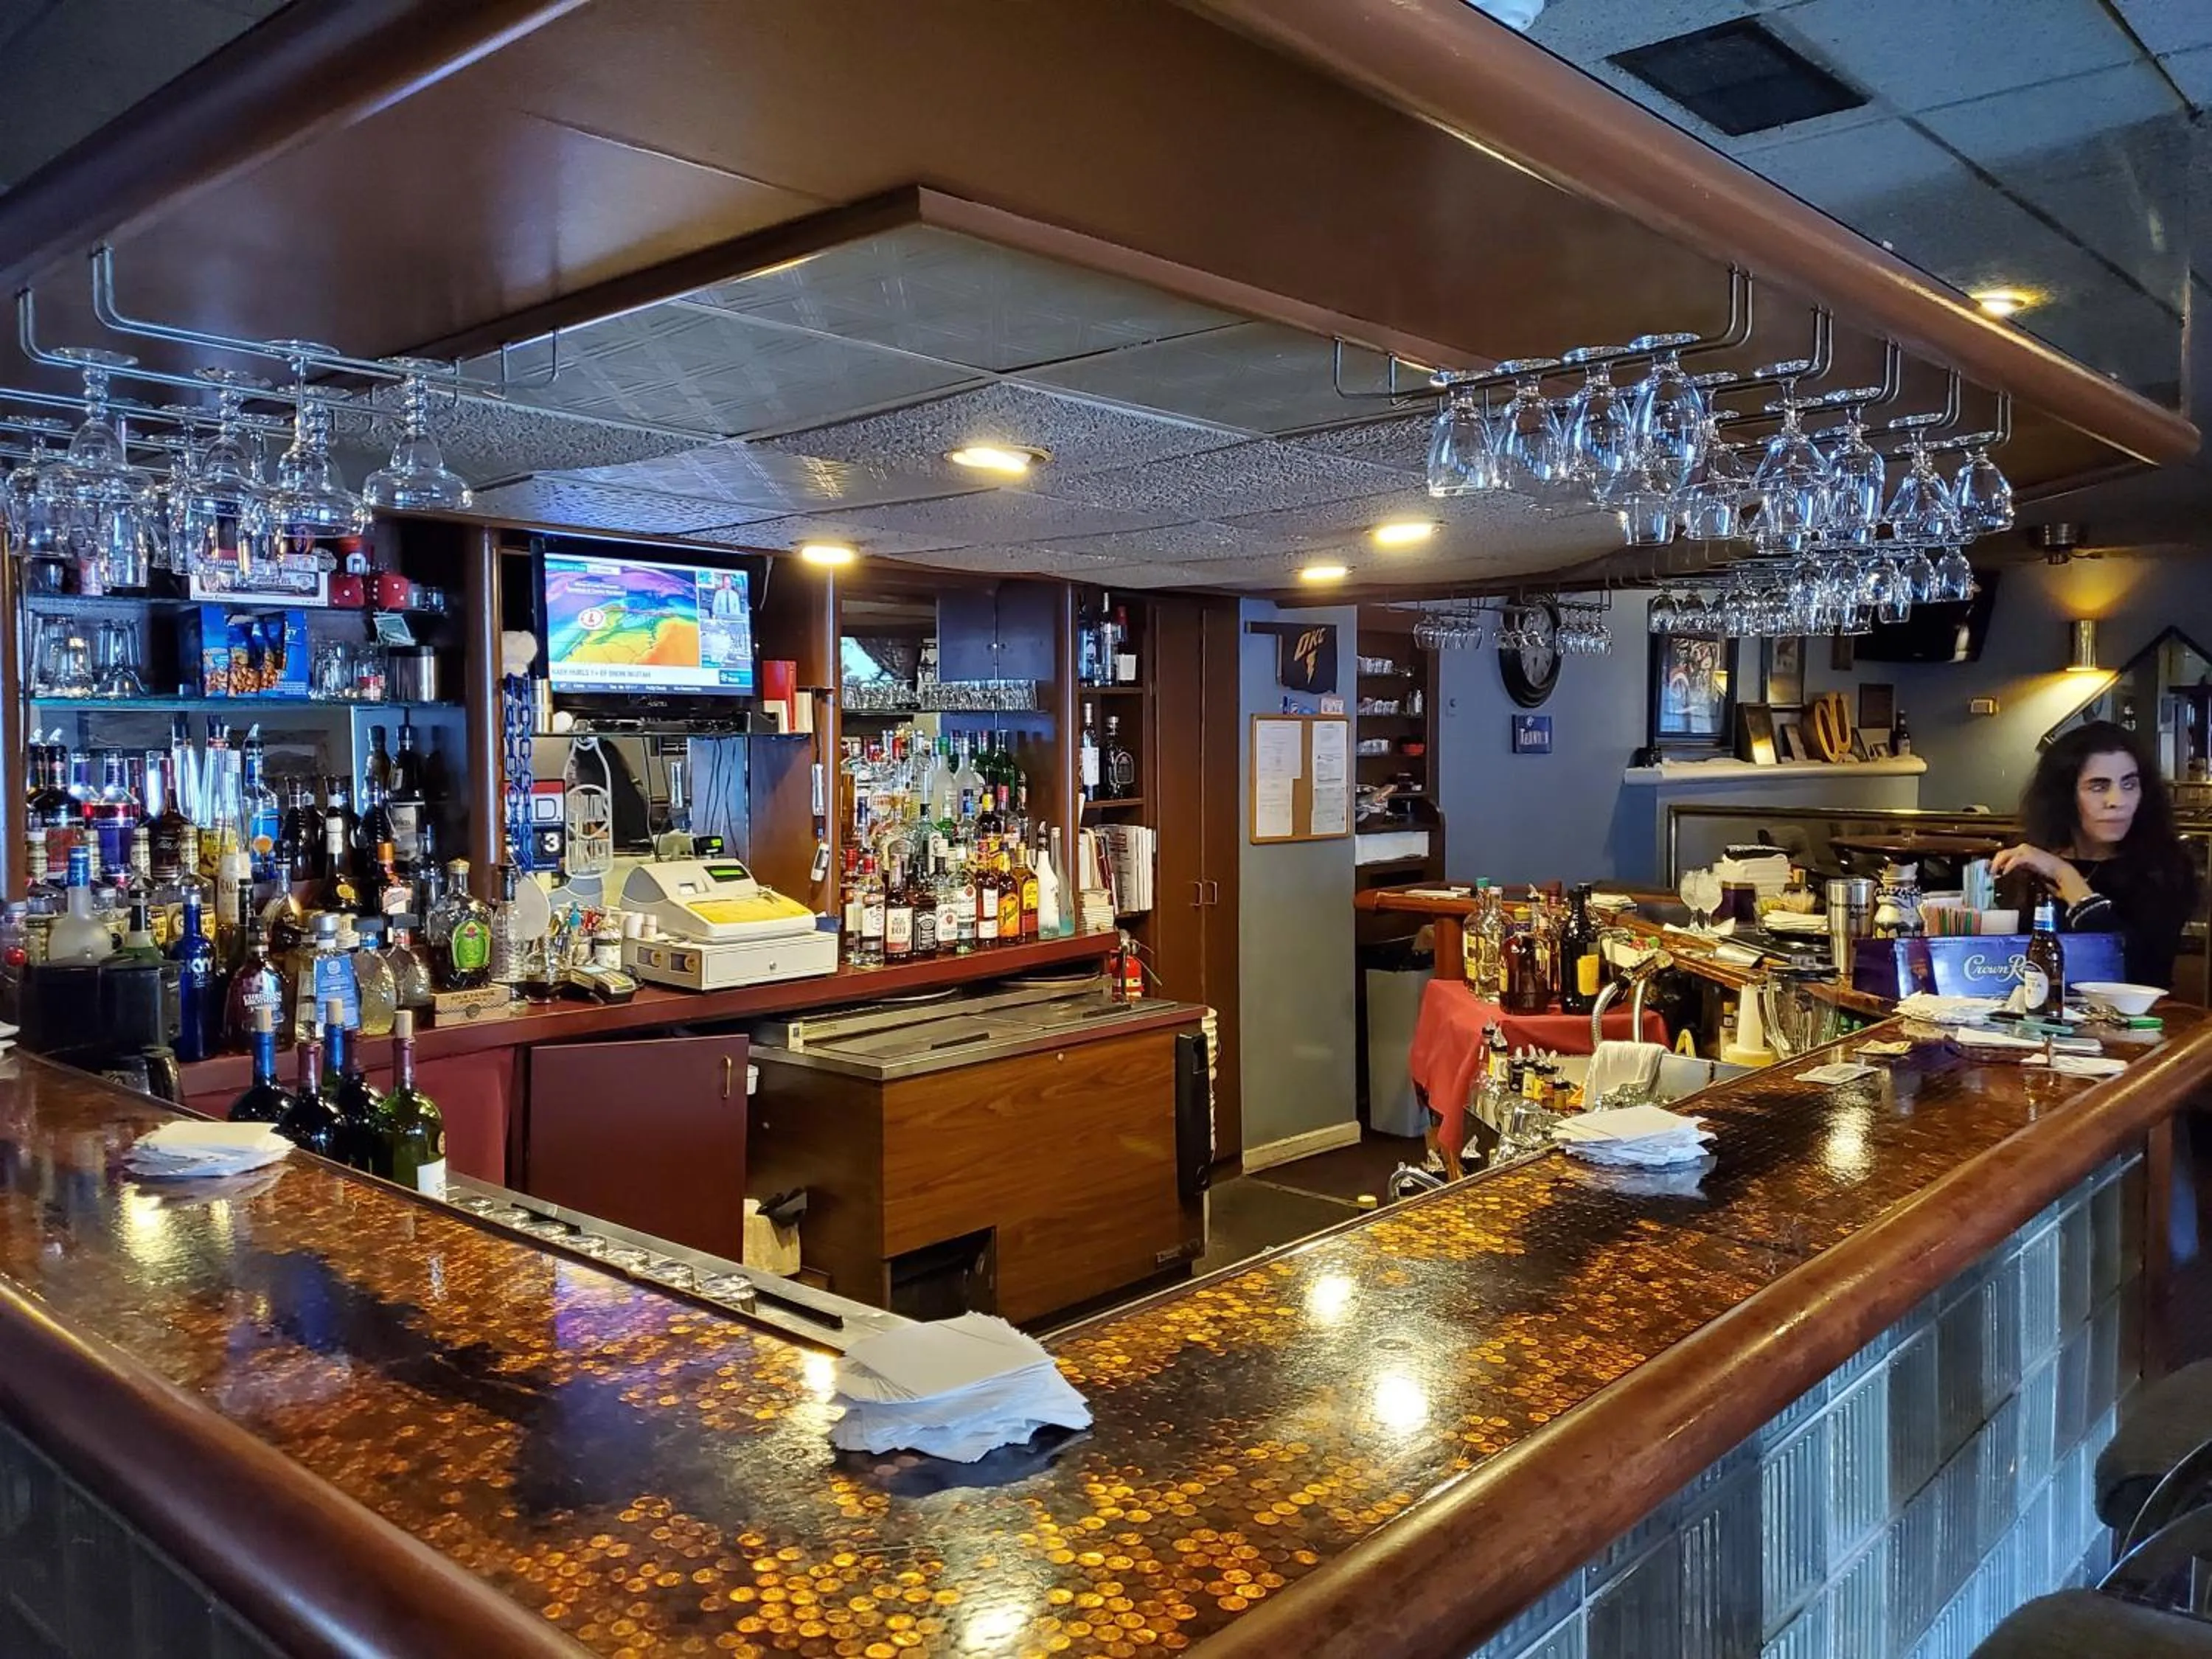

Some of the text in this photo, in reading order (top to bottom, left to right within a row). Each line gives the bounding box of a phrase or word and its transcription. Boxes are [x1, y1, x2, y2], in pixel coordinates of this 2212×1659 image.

[1293, 627, 1326, 661] OKC
[545, 831, 560, 852] 3
[1964, 954, 2009, 982] Crown
